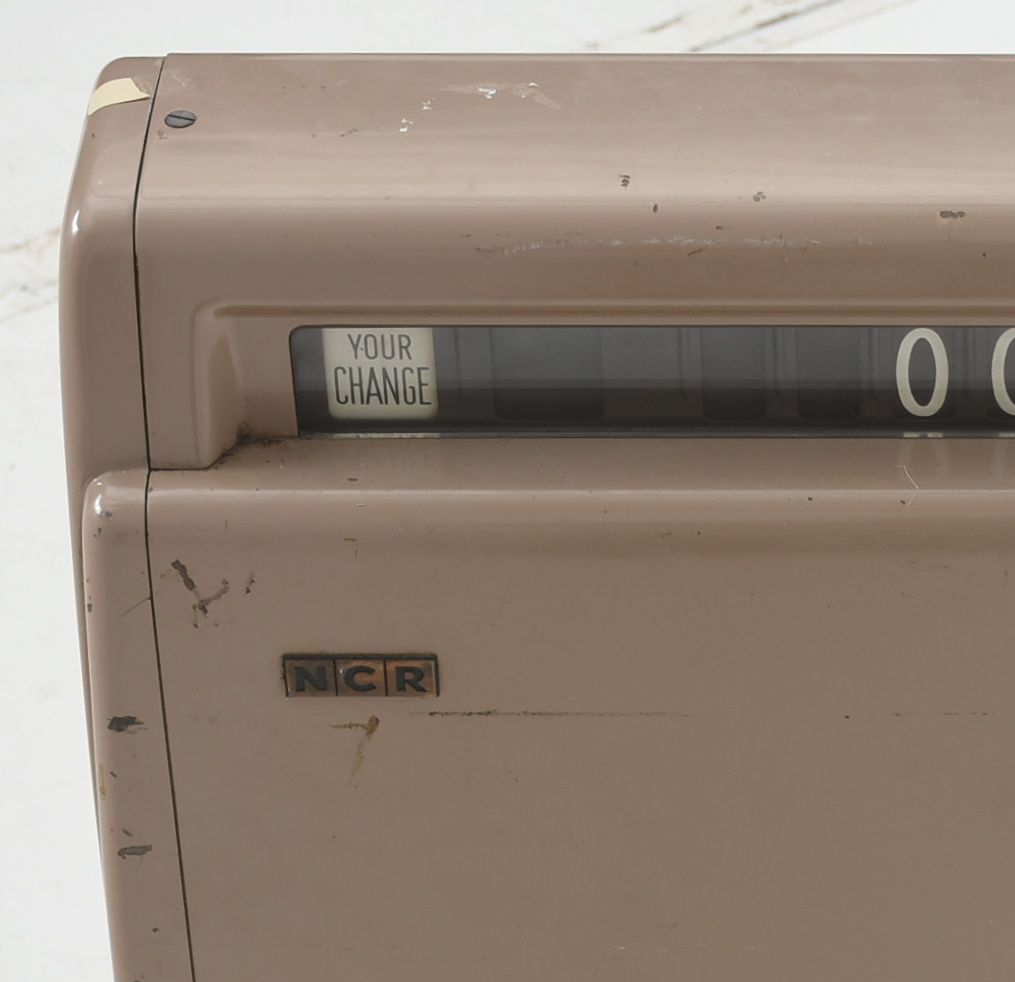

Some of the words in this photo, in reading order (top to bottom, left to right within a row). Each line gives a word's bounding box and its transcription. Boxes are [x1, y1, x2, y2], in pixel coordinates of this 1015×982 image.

[347, 333, 412, 360] YOUR
[334, 366, 432, 405] CHANGE
[294, 665, 428, 693] NCR
